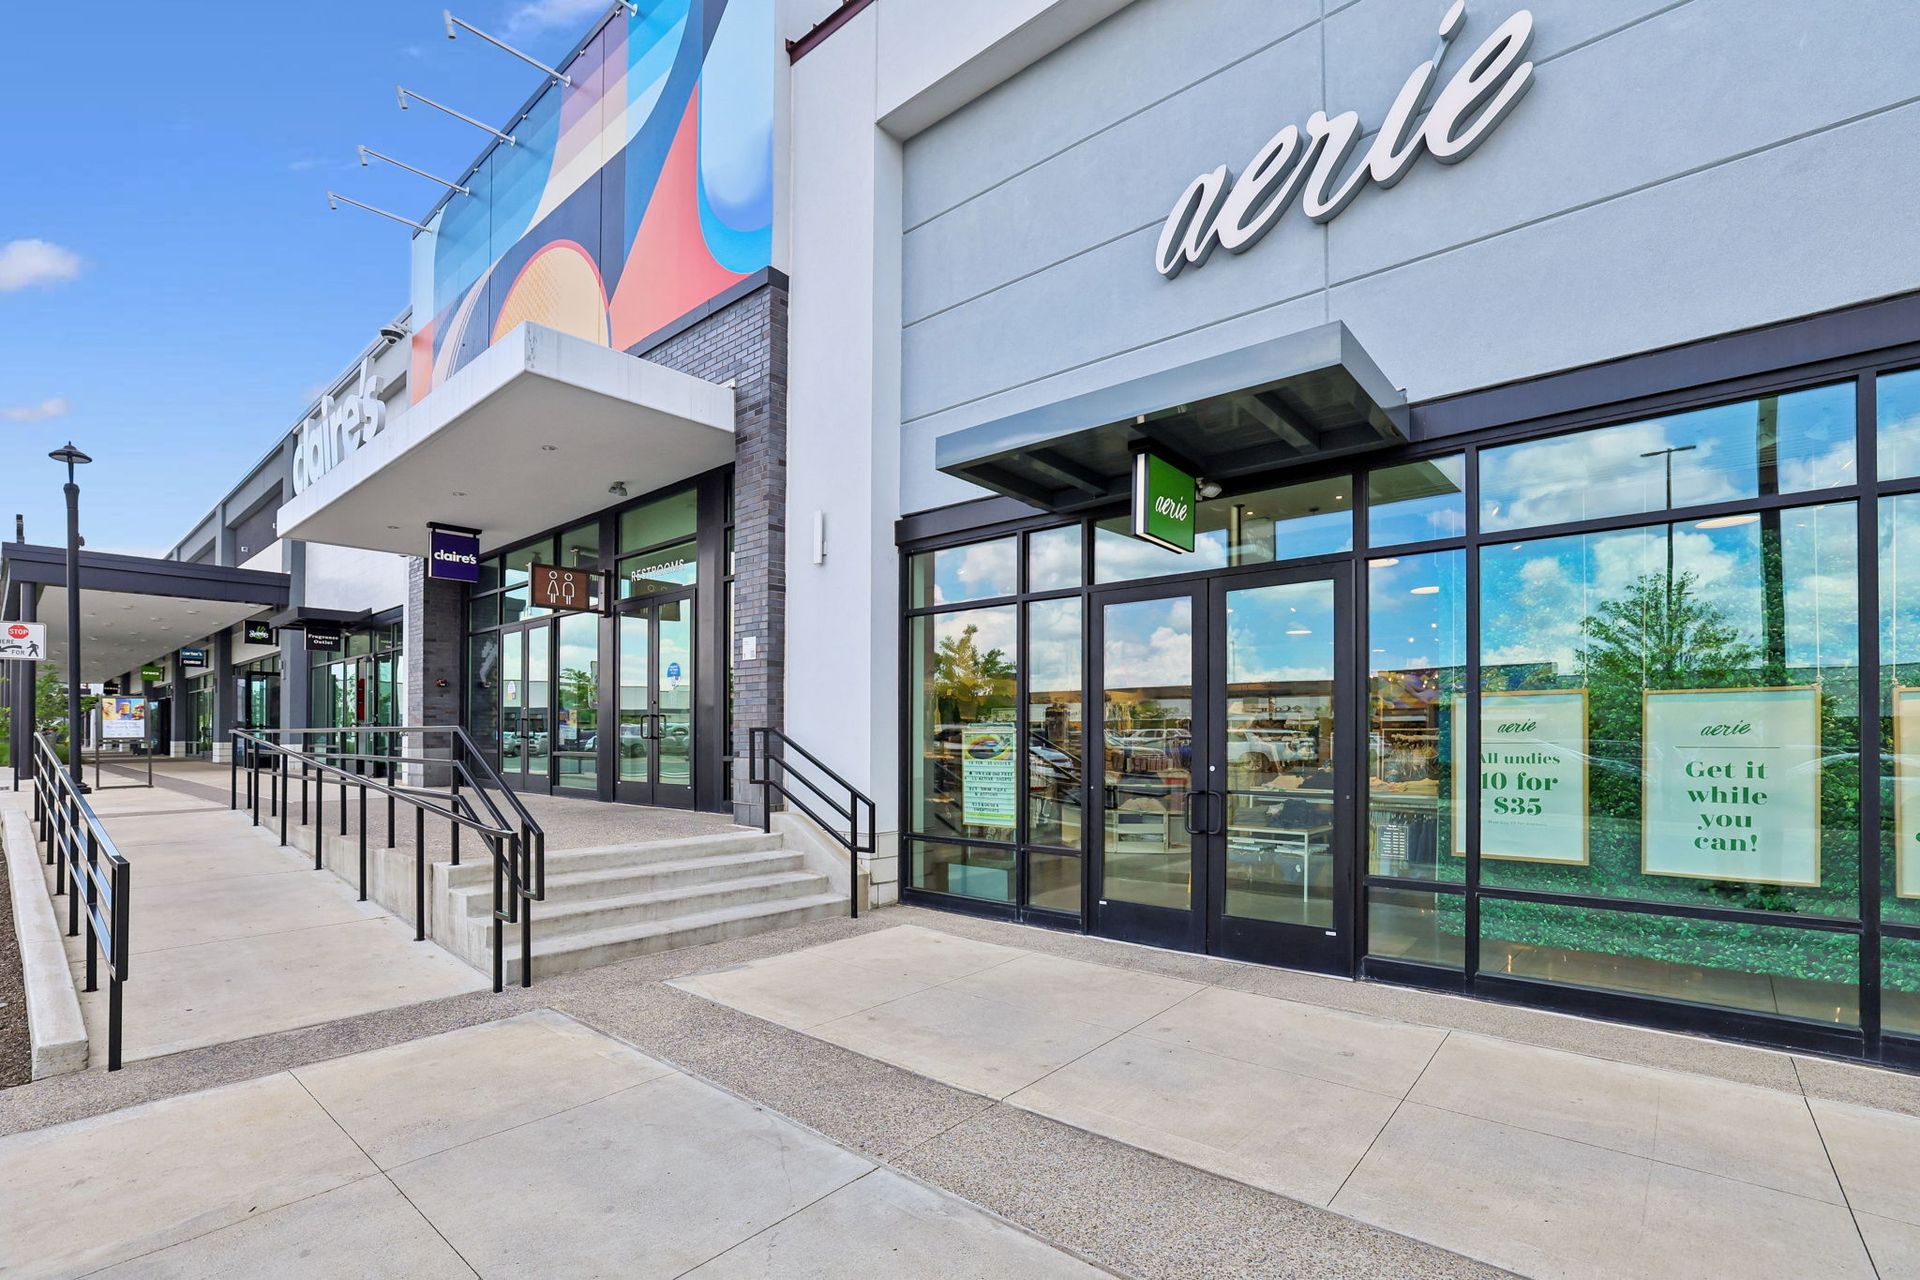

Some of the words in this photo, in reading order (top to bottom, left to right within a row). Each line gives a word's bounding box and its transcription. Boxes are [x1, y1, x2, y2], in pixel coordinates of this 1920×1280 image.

[1156, 0, 1536, 280] aerie
[293, 357, 386, 496] claire's
[1155, 496, 1187, 521] aerie
[434, 549, 477, 564] claire's
[631, 559, 684, 582] RESTROOMS
[1497, 718, 1537, 733] aerie
[1700, 720, 1751, 736] aerie
[1504, 752, 1561, 765] undies
[1685, 760, 1736, 779] Get
[1745, 760, 1769, 779] it
[1481, 772, 1507, 790] 10
[1517, 772, 1559, 791] for
[1687, 786, 1768, 806] while
[1493, 796, 1542, 816] $35
[1697, 814, 1752, 832] you
[1694, 834, 1758, 852] can!
